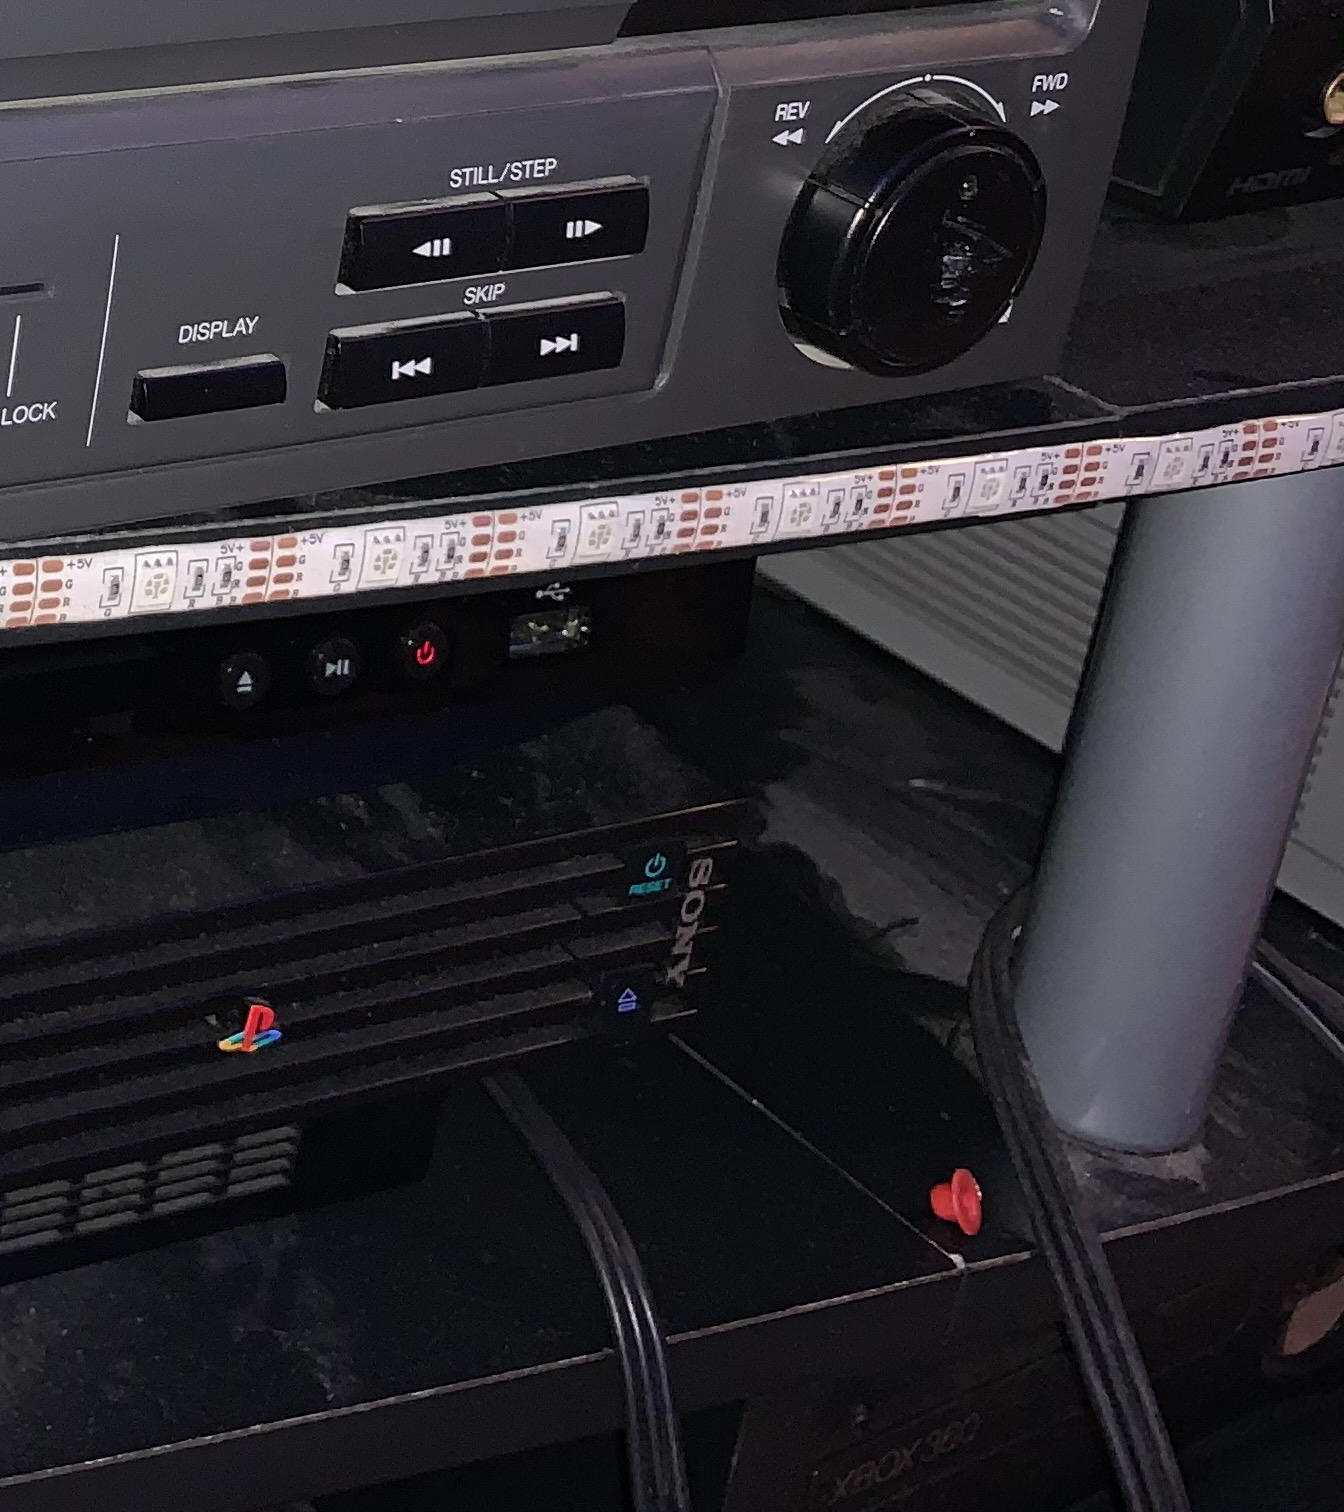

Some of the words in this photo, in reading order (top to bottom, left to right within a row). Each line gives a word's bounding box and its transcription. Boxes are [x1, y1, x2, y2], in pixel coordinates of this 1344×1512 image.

[1031, 73, 1069, 92] FWD
[774, 100, 811, 122] REV
[449, 157, 558, 189] STILL/STEP
[463, 282, 506, 306] SKIP
[178, 316, 259, 345] DISPLAY
[1, 401, 57, 427] LOCK
[220, 543, 245, 555] 5V+
[300, 532, 325, 546] +5V
[66, 557, 93, 571] +5V
[665, 858, 713, 988] SONY
